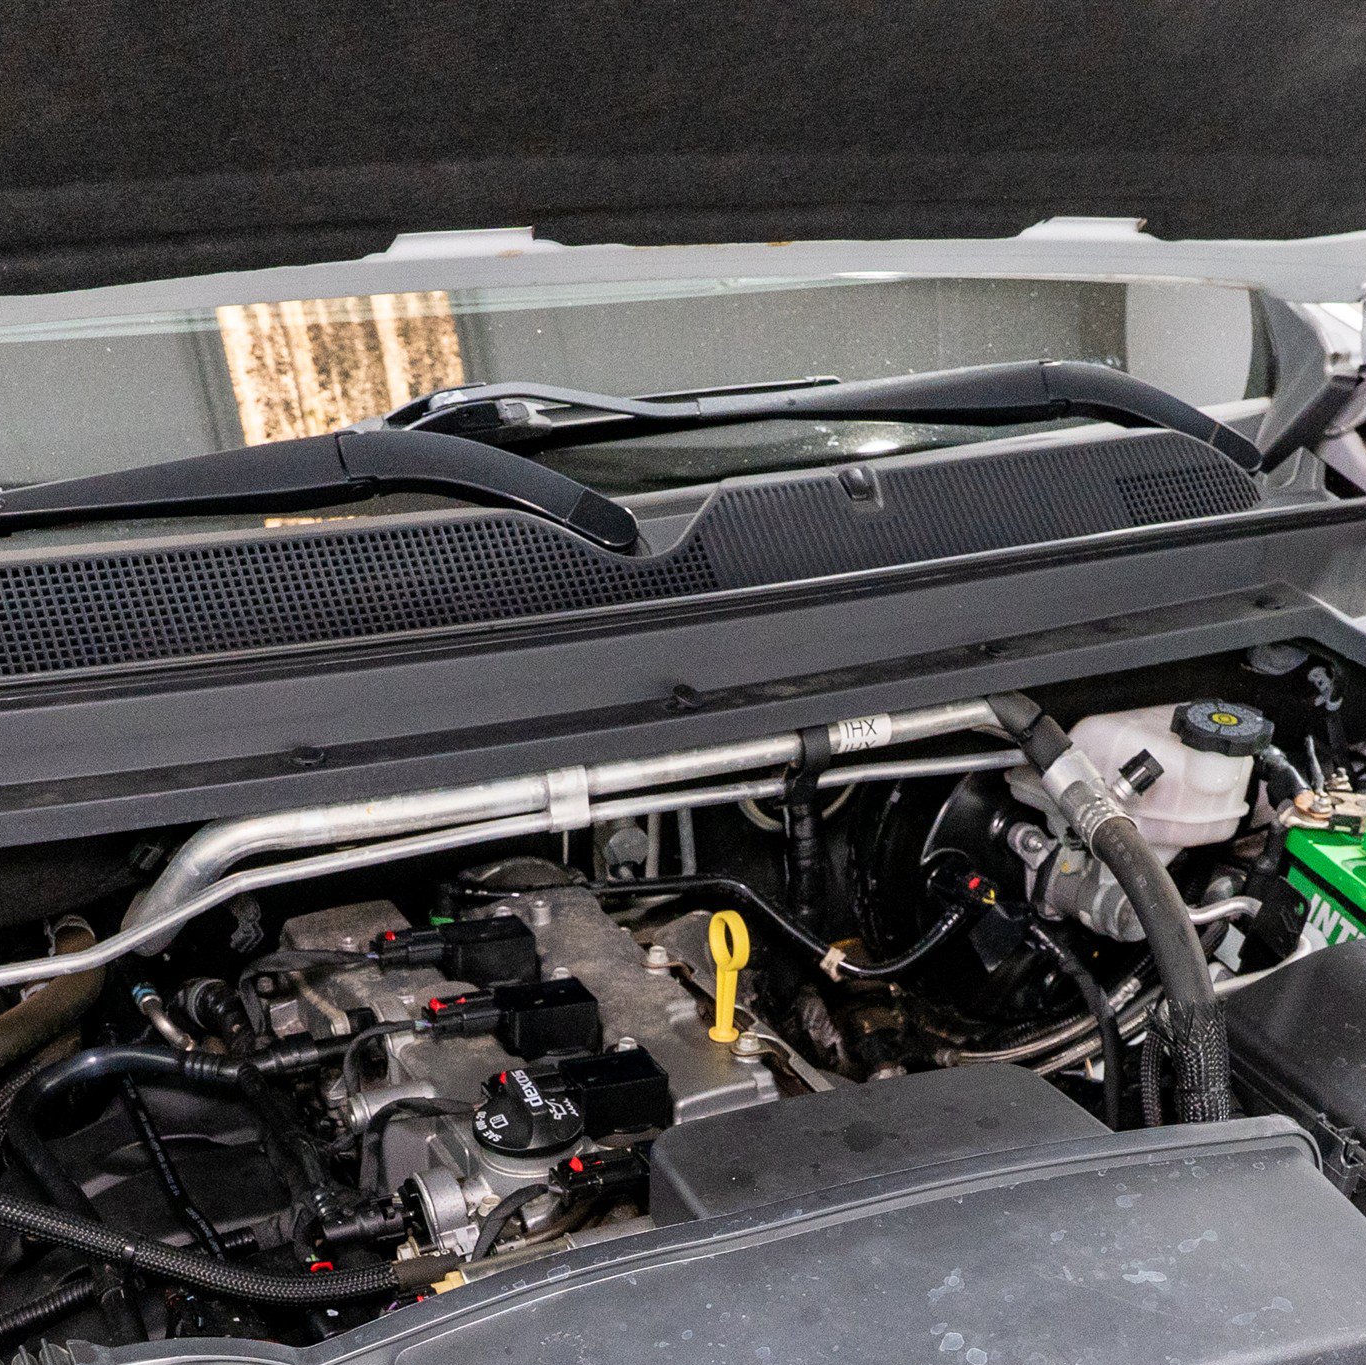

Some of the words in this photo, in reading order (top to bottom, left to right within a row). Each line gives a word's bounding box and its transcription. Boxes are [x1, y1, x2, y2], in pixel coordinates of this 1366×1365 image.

[844, 719, 877, 738] IHX
[511, 1069, 543, 1107] dexos
[483, 1130, 502, 1142] SAE
